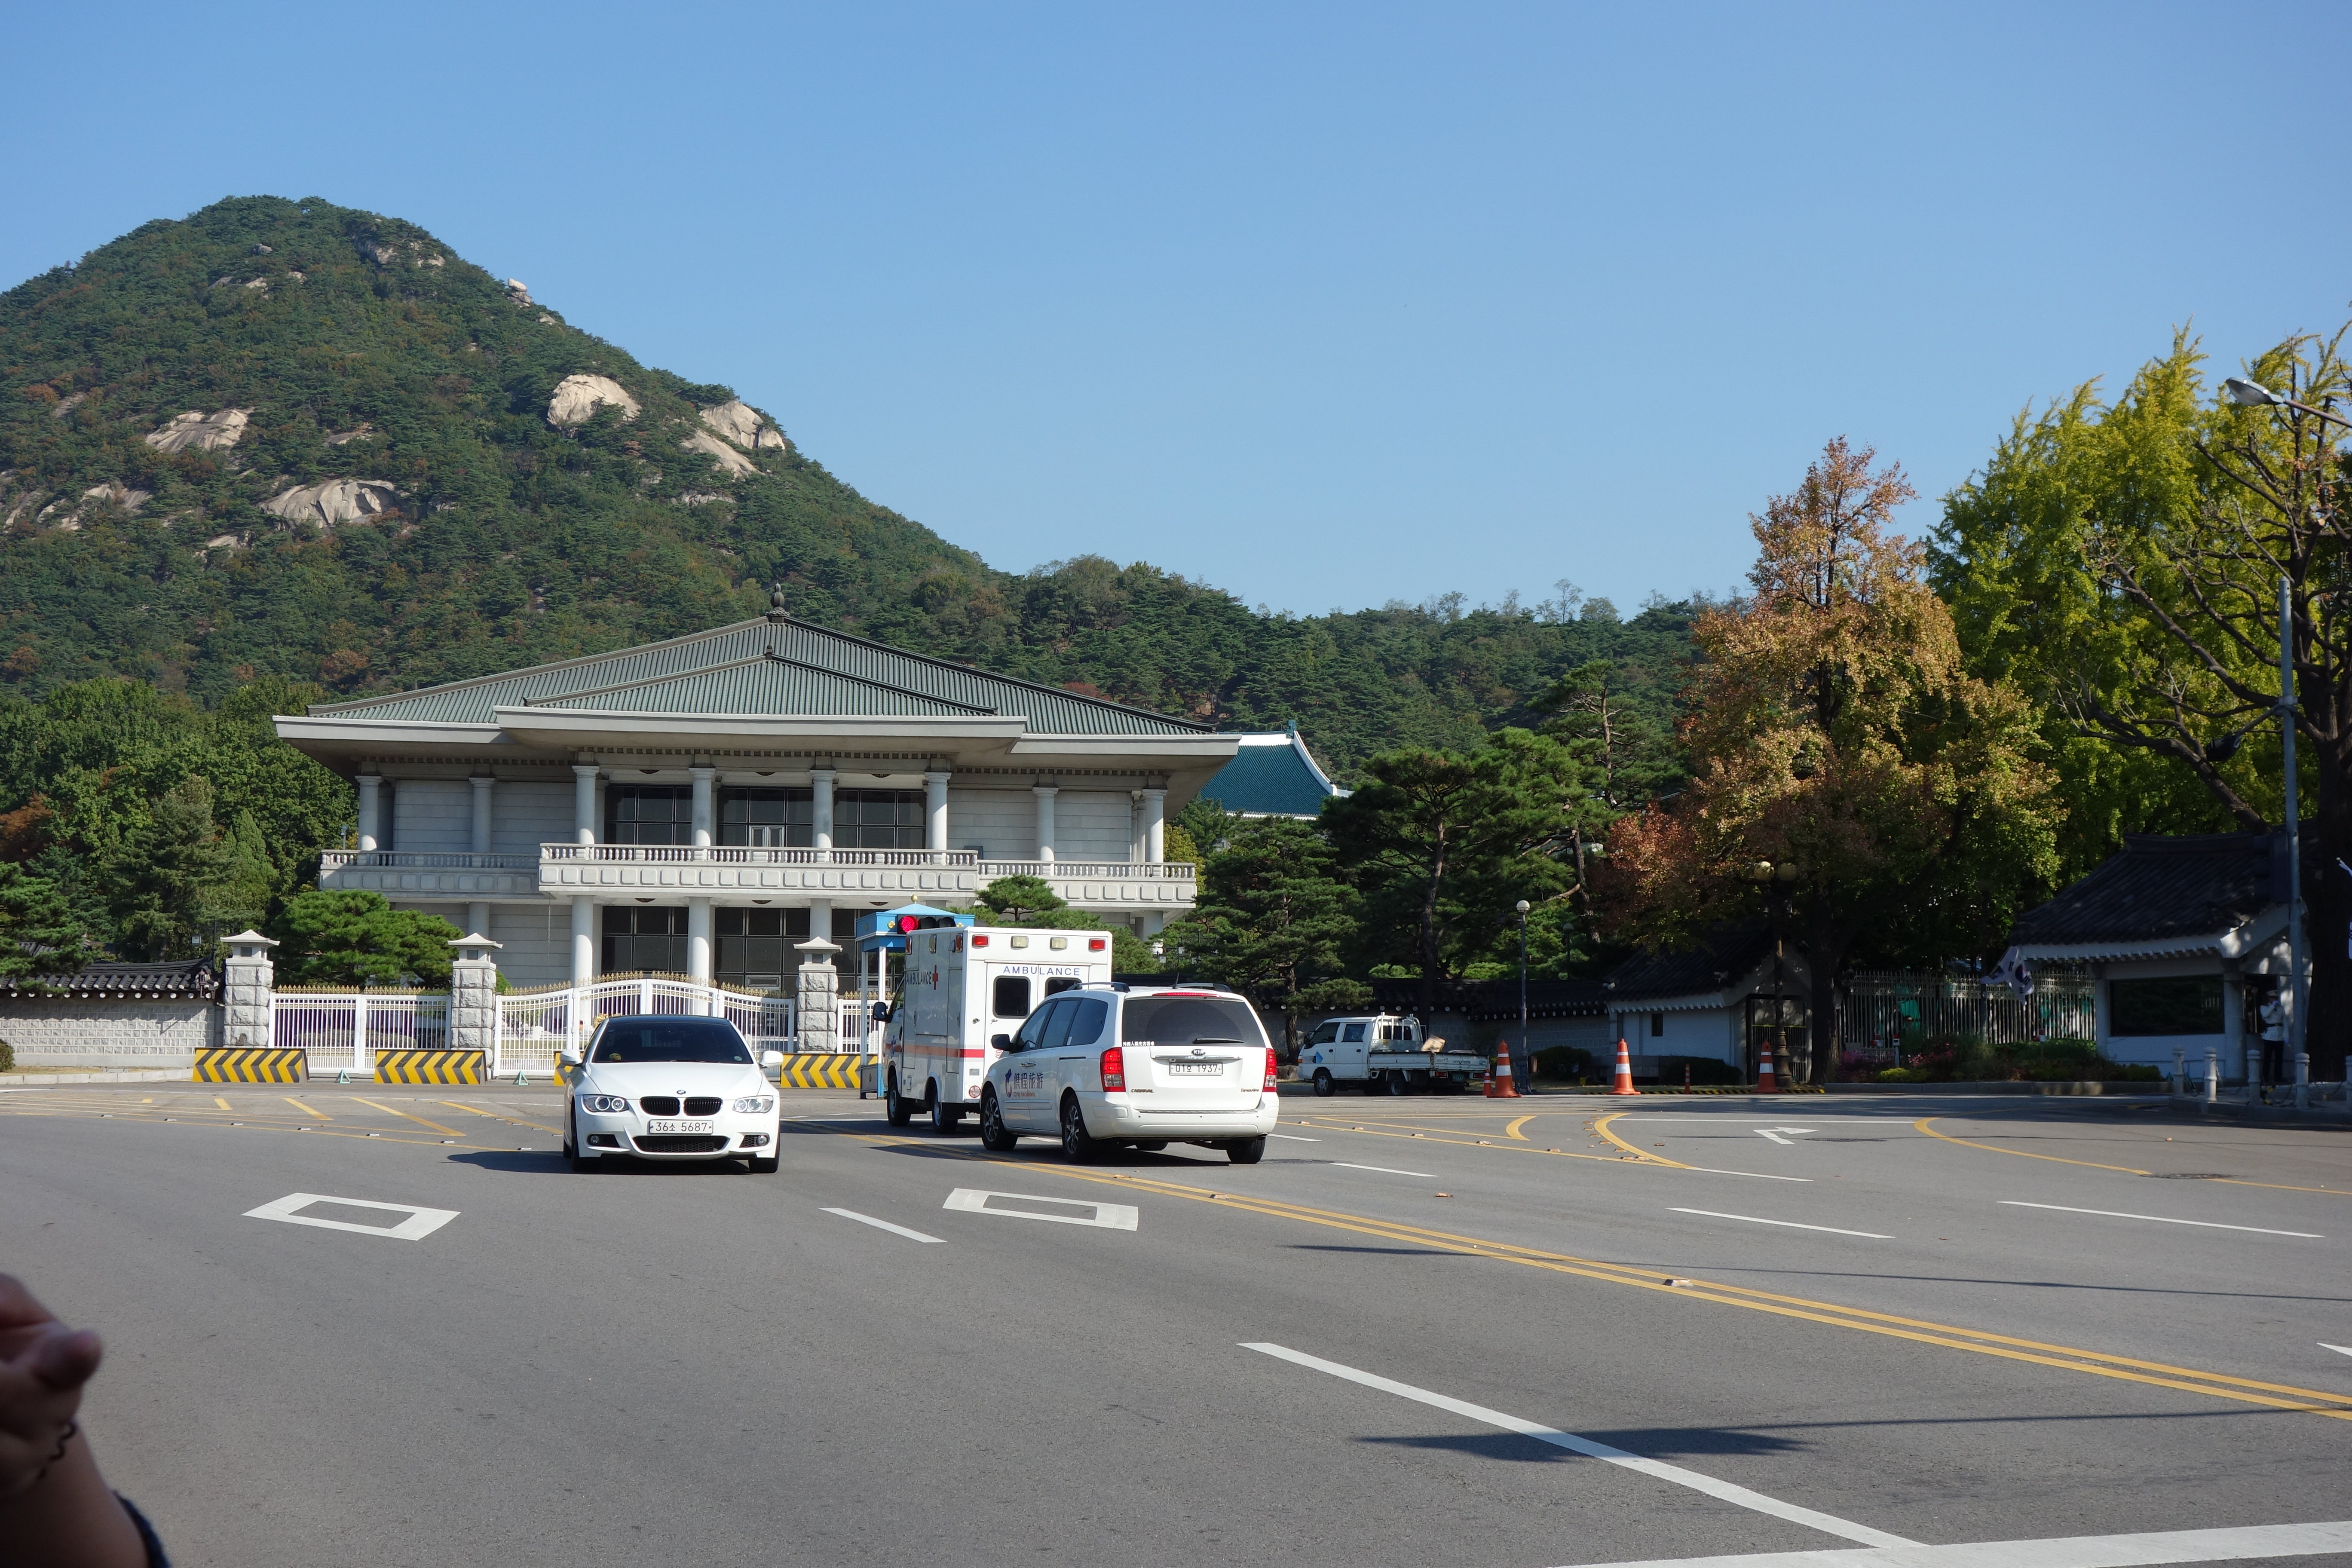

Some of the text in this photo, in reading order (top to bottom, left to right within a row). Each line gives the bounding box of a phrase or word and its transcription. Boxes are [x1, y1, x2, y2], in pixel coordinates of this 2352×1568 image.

[1003, 966, 1080, 976] AMBULANCE
[906, 972, 931, 985] AMBULANCE
[1176, 1064, 1217, 1072] 01호 1937
[1014, 1072, 1043, 1089] 携程旅游
[655, 1122, 707, 1132] 36소 5687
